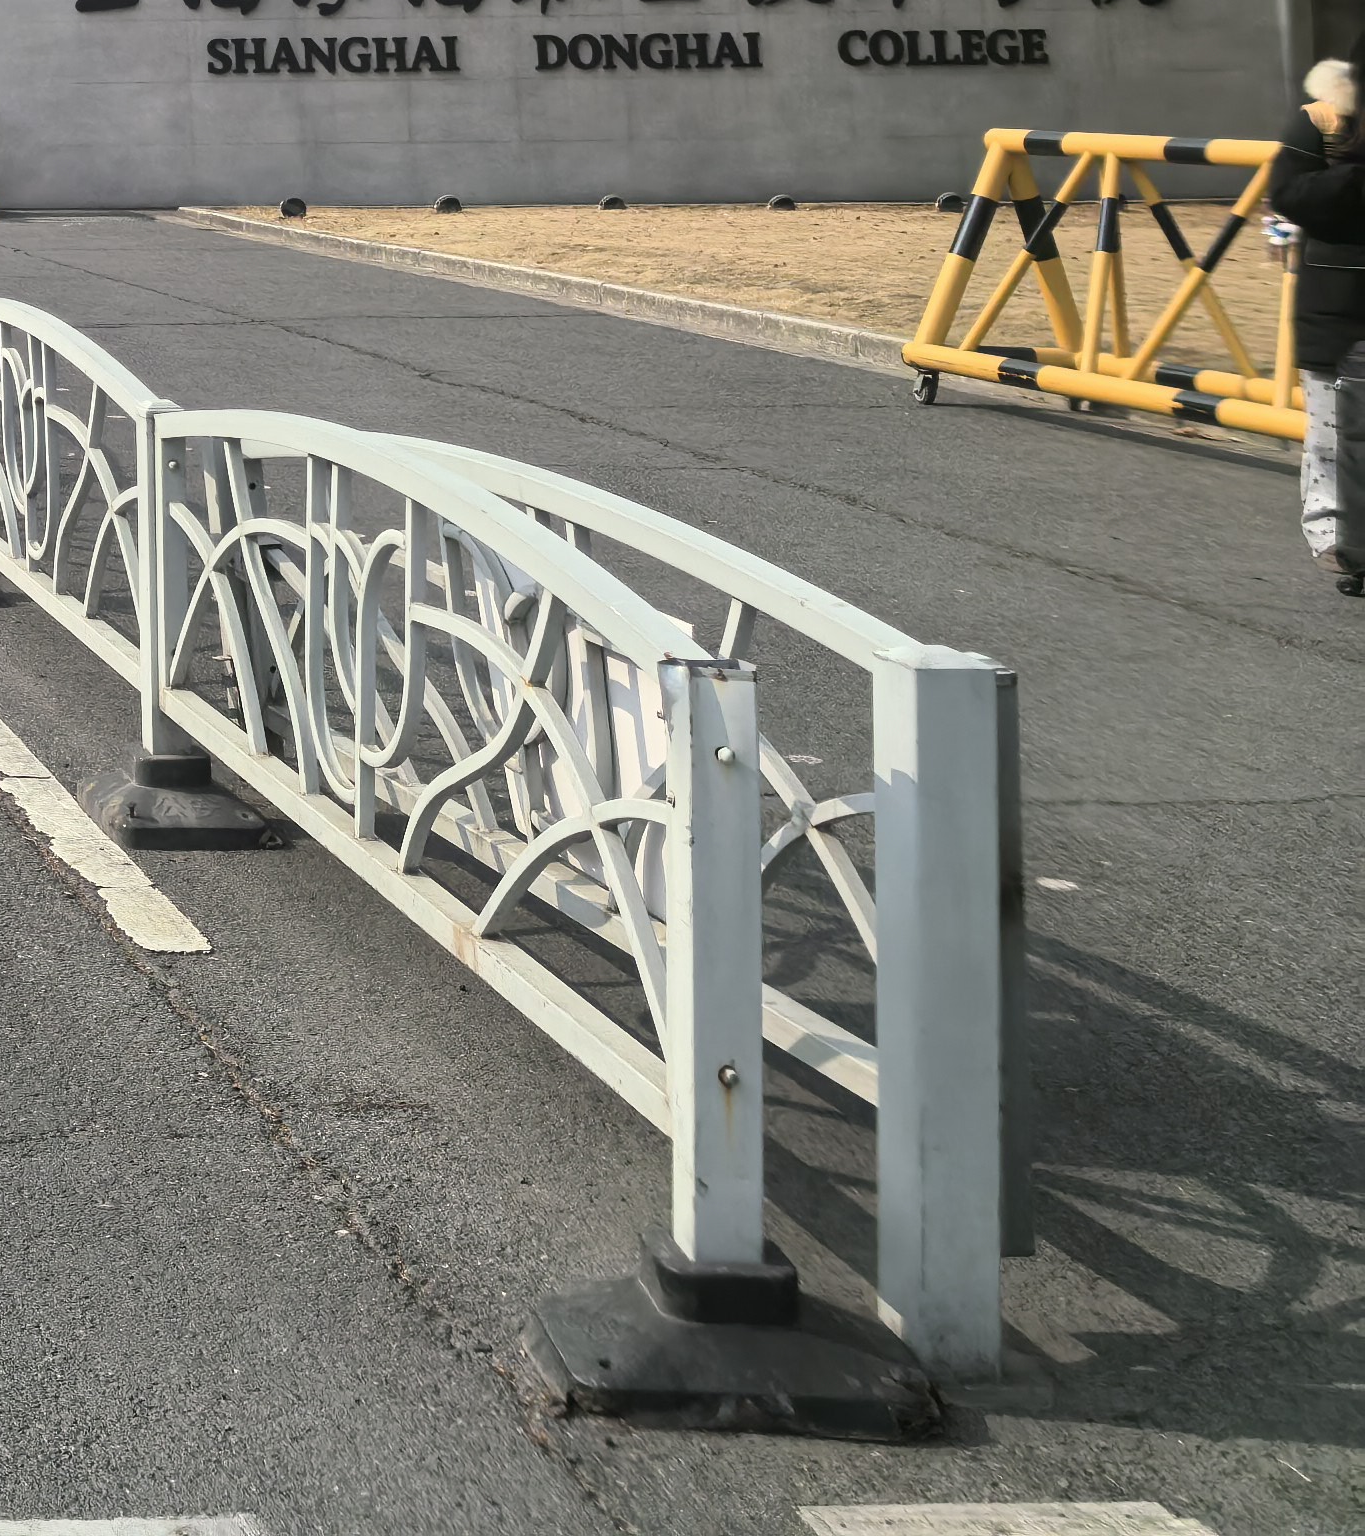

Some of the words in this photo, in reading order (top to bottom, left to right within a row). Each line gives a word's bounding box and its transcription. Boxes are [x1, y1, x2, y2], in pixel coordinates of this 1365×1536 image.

[206, 35, 461, 76] SHANGHAI
[534, 31, 764, 71] DONGHAI
[837, 27, 1051, 69] COLLEGE
